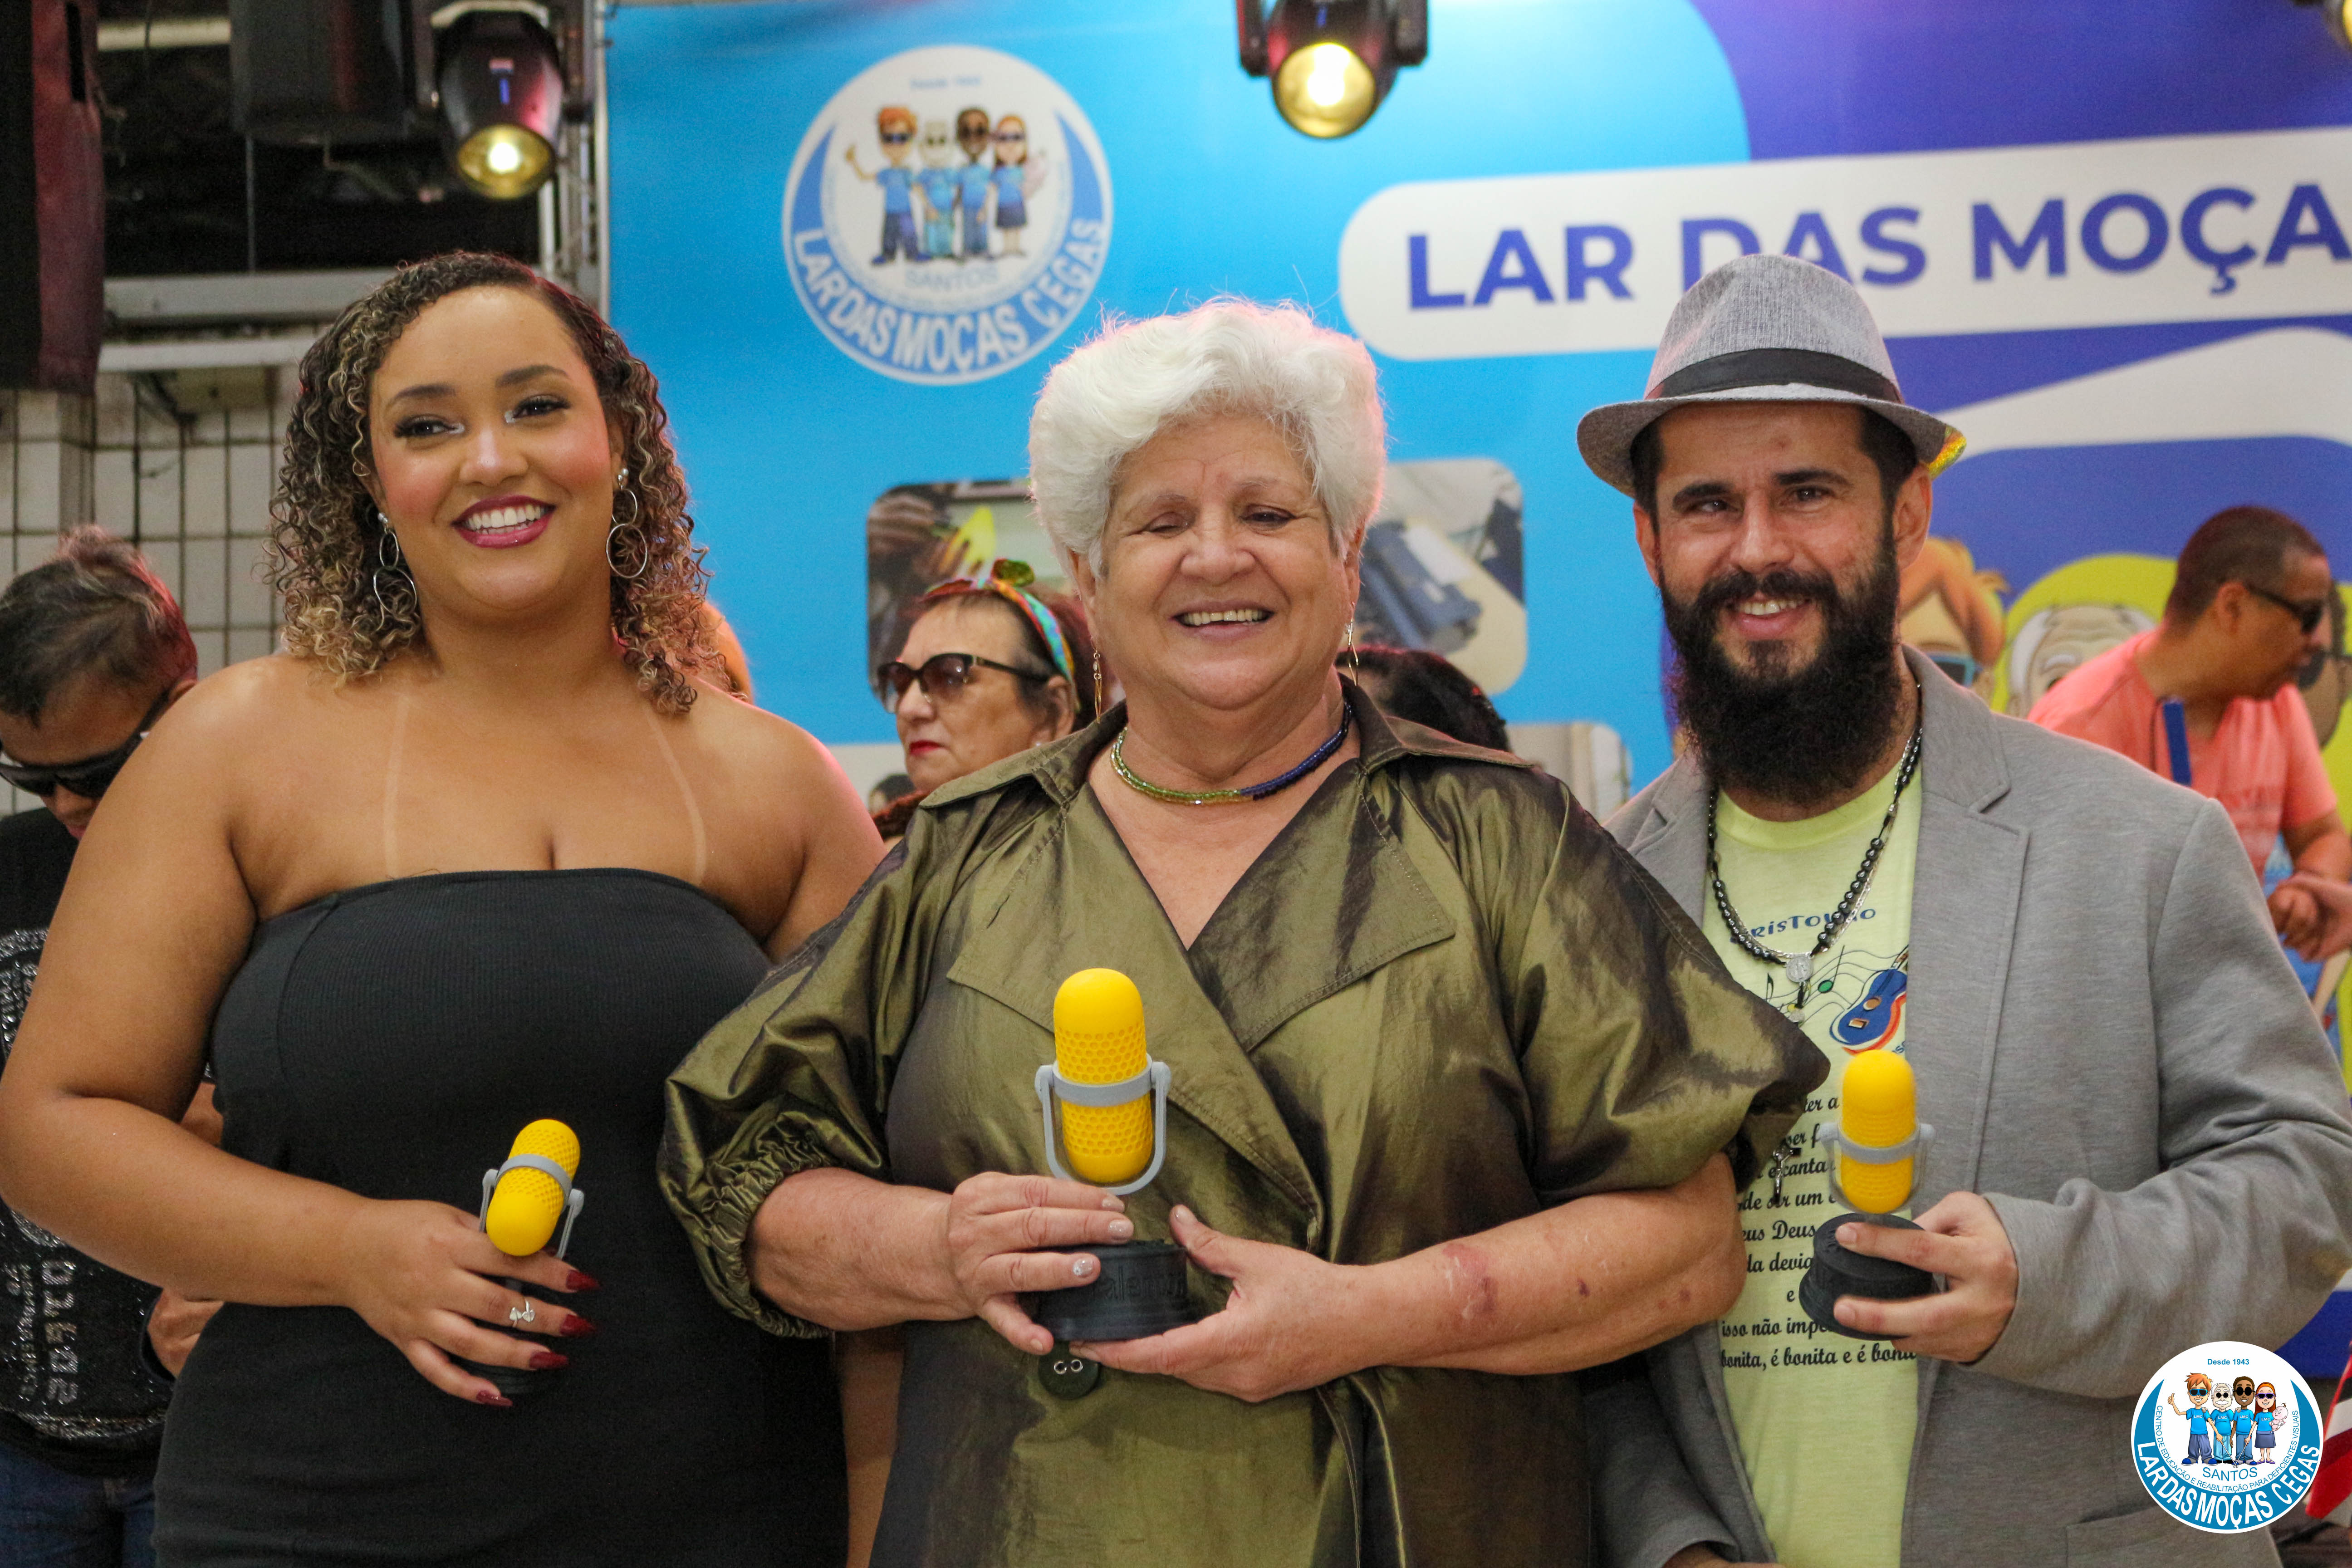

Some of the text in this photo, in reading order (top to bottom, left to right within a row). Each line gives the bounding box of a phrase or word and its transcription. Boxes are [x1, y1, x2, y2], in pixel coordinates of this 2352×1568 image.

[1408, 225, 1635, 309] LAR
[1971, 184, 2352, 297] MOÇA
[794, 229, 850, 309] LAR
[828, 289, 896, 358] DAS
[1022, 216, 1106, 328] CEGAS
[1795, 1192, 1824, 1207] um
[1772, 1220, 1815, 1240] Deus
[1787, 1290, 1795, 1303] e
[1722, 1321, 1749, 1337] isso
[1752, 1318, 1782, 1336] não
[1771, 1348, 1779, 1367] é
[1783, 1346, 1838, 1366] bonita
[1843, 1351, 1852, 1364] e
[1857, 1344, 1867, 1363] é
